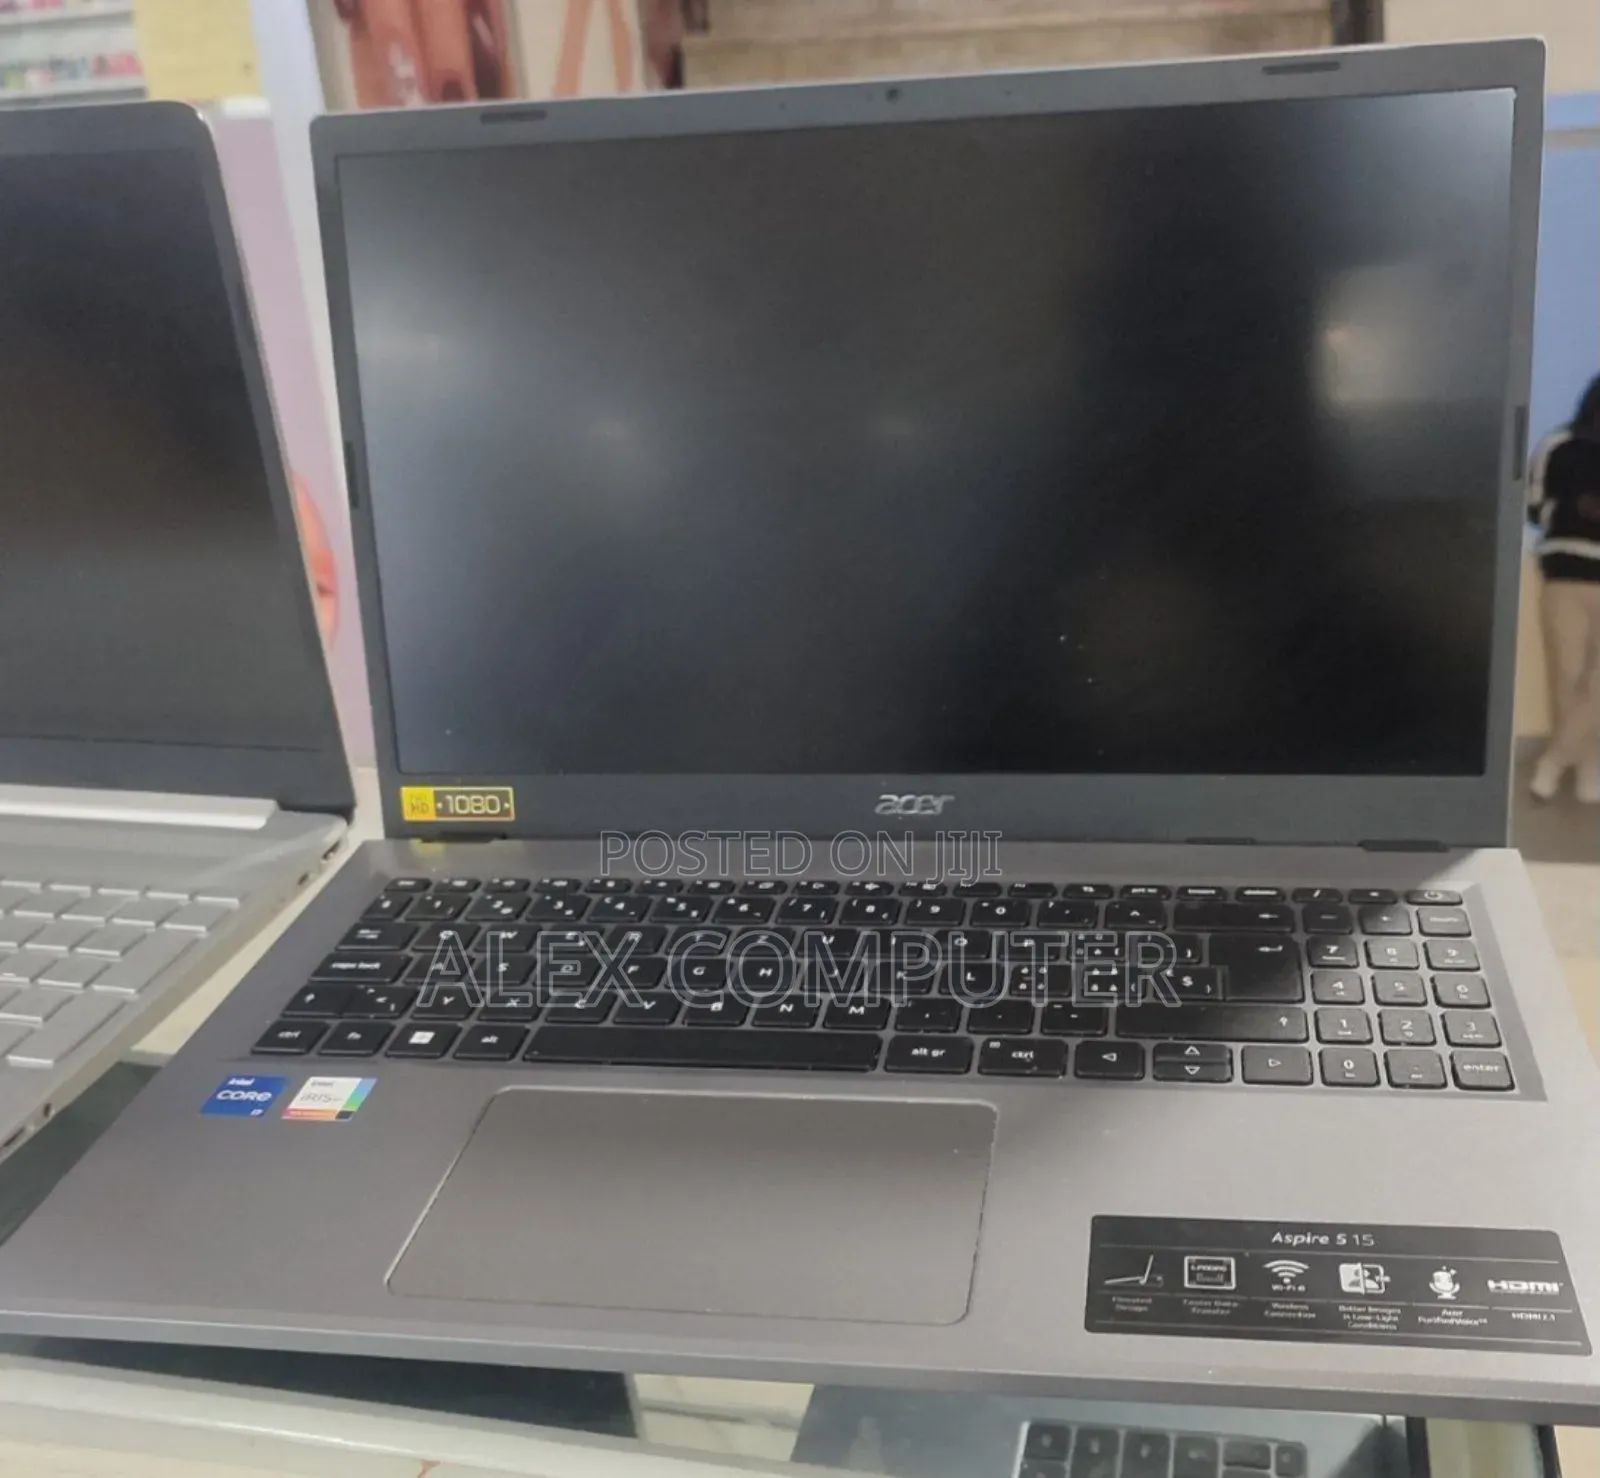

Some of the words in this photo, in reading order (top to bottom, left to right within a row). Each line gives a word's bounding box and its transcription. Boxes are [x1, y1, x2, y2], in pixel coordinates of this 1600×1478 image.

[445, 795, 500, 814] 1080
[875, 794, 955, 815] acer
[1271, 1231, 1329, 1247] Aspire
[1352, 1233, 1375, 1247] 15
[1487, 1279, 1560, 1294] HDMI
